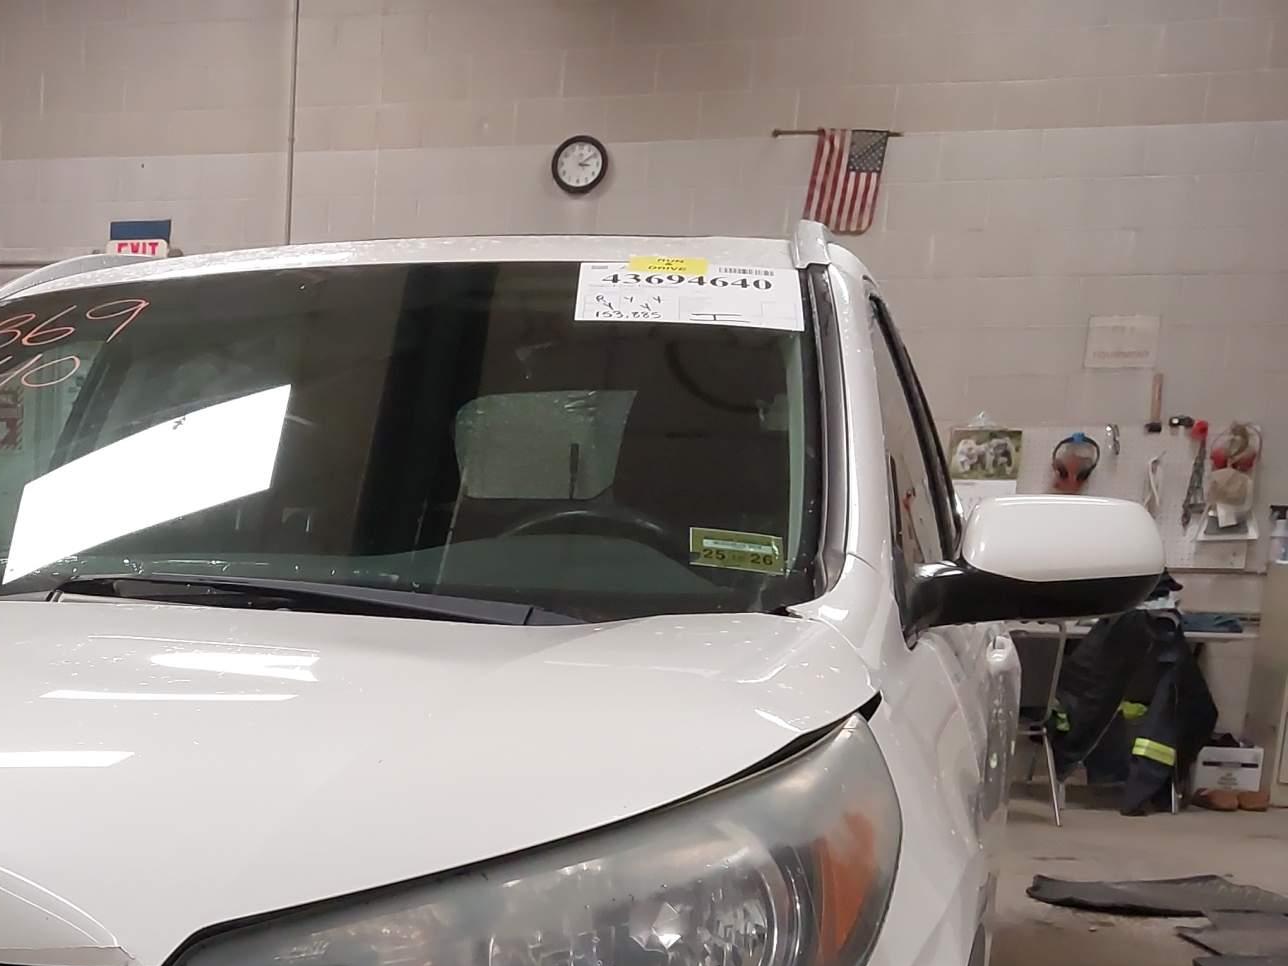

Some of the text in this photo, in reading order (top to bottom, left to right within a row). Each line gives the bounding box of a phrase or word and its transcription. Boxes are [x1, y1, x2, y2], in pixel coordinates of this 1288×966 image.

[602, 273, 772, 290] 43694640
[702, 548, 774, 566] 25 26
